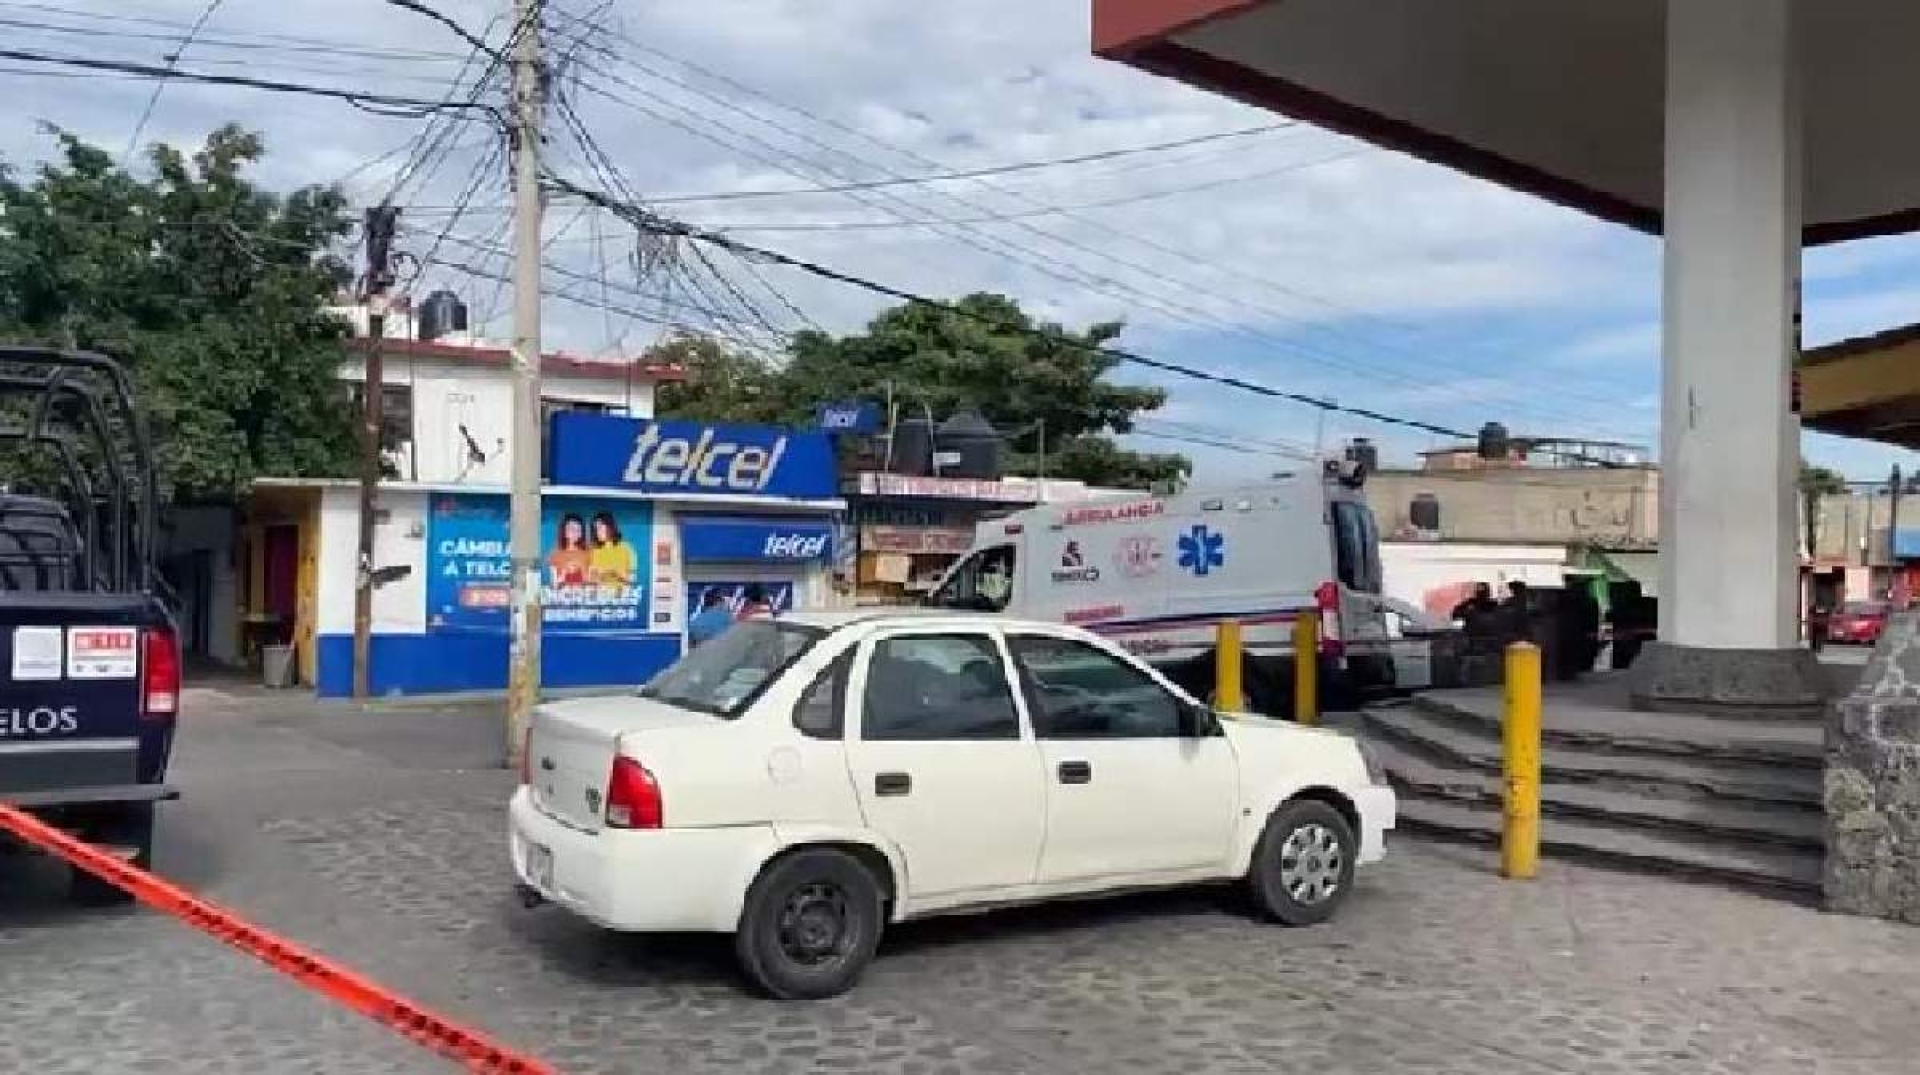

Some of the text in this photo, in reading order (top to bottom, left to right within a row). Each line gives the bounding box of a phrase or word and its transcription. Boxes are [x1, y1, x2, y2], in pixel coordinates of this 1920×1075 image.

[622, 422, 788, 489] telcel
[763, 531, 826, 556] telcel
[466, 559, 511, 576] TELC
